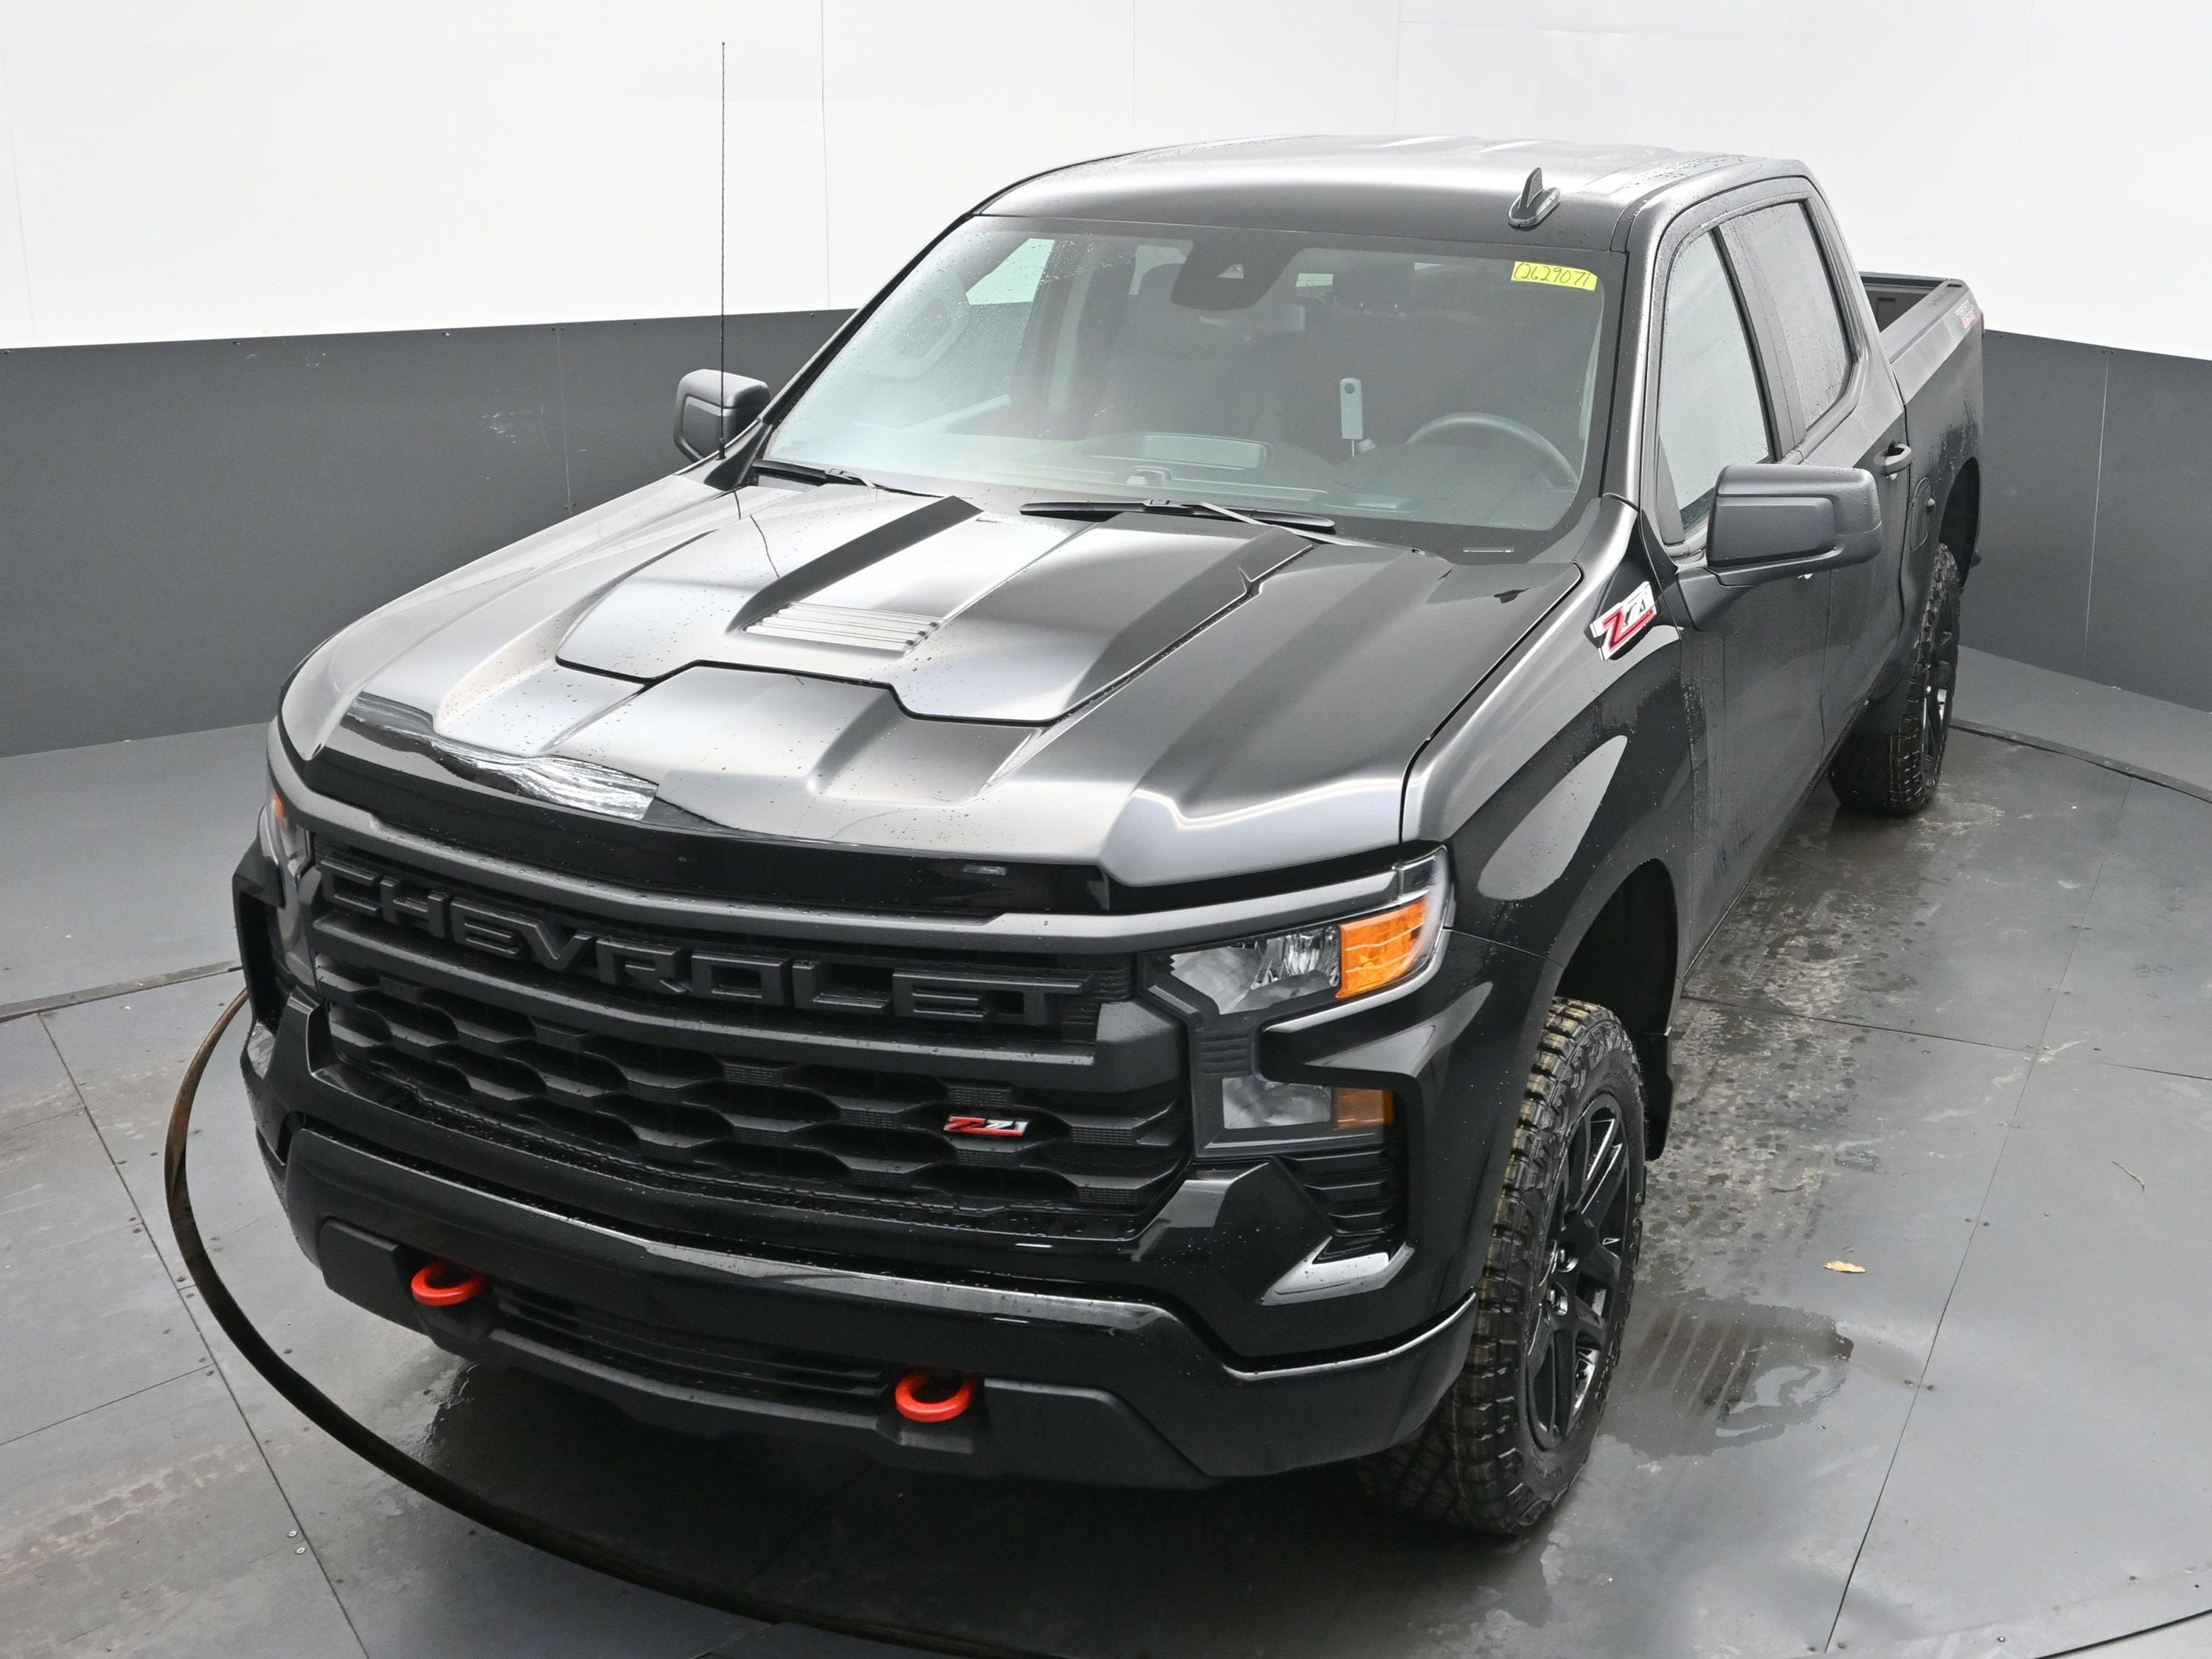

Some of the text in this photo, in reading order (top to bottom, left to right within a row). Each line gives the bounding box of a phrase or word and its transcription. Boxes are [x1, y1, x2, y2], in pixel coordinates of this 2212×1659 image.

[1590, 581, 1657, 661] Z71
[319, 858, 1085, 1026] CHEVROLET
[943, 1116, 1029, 1137] Z71
